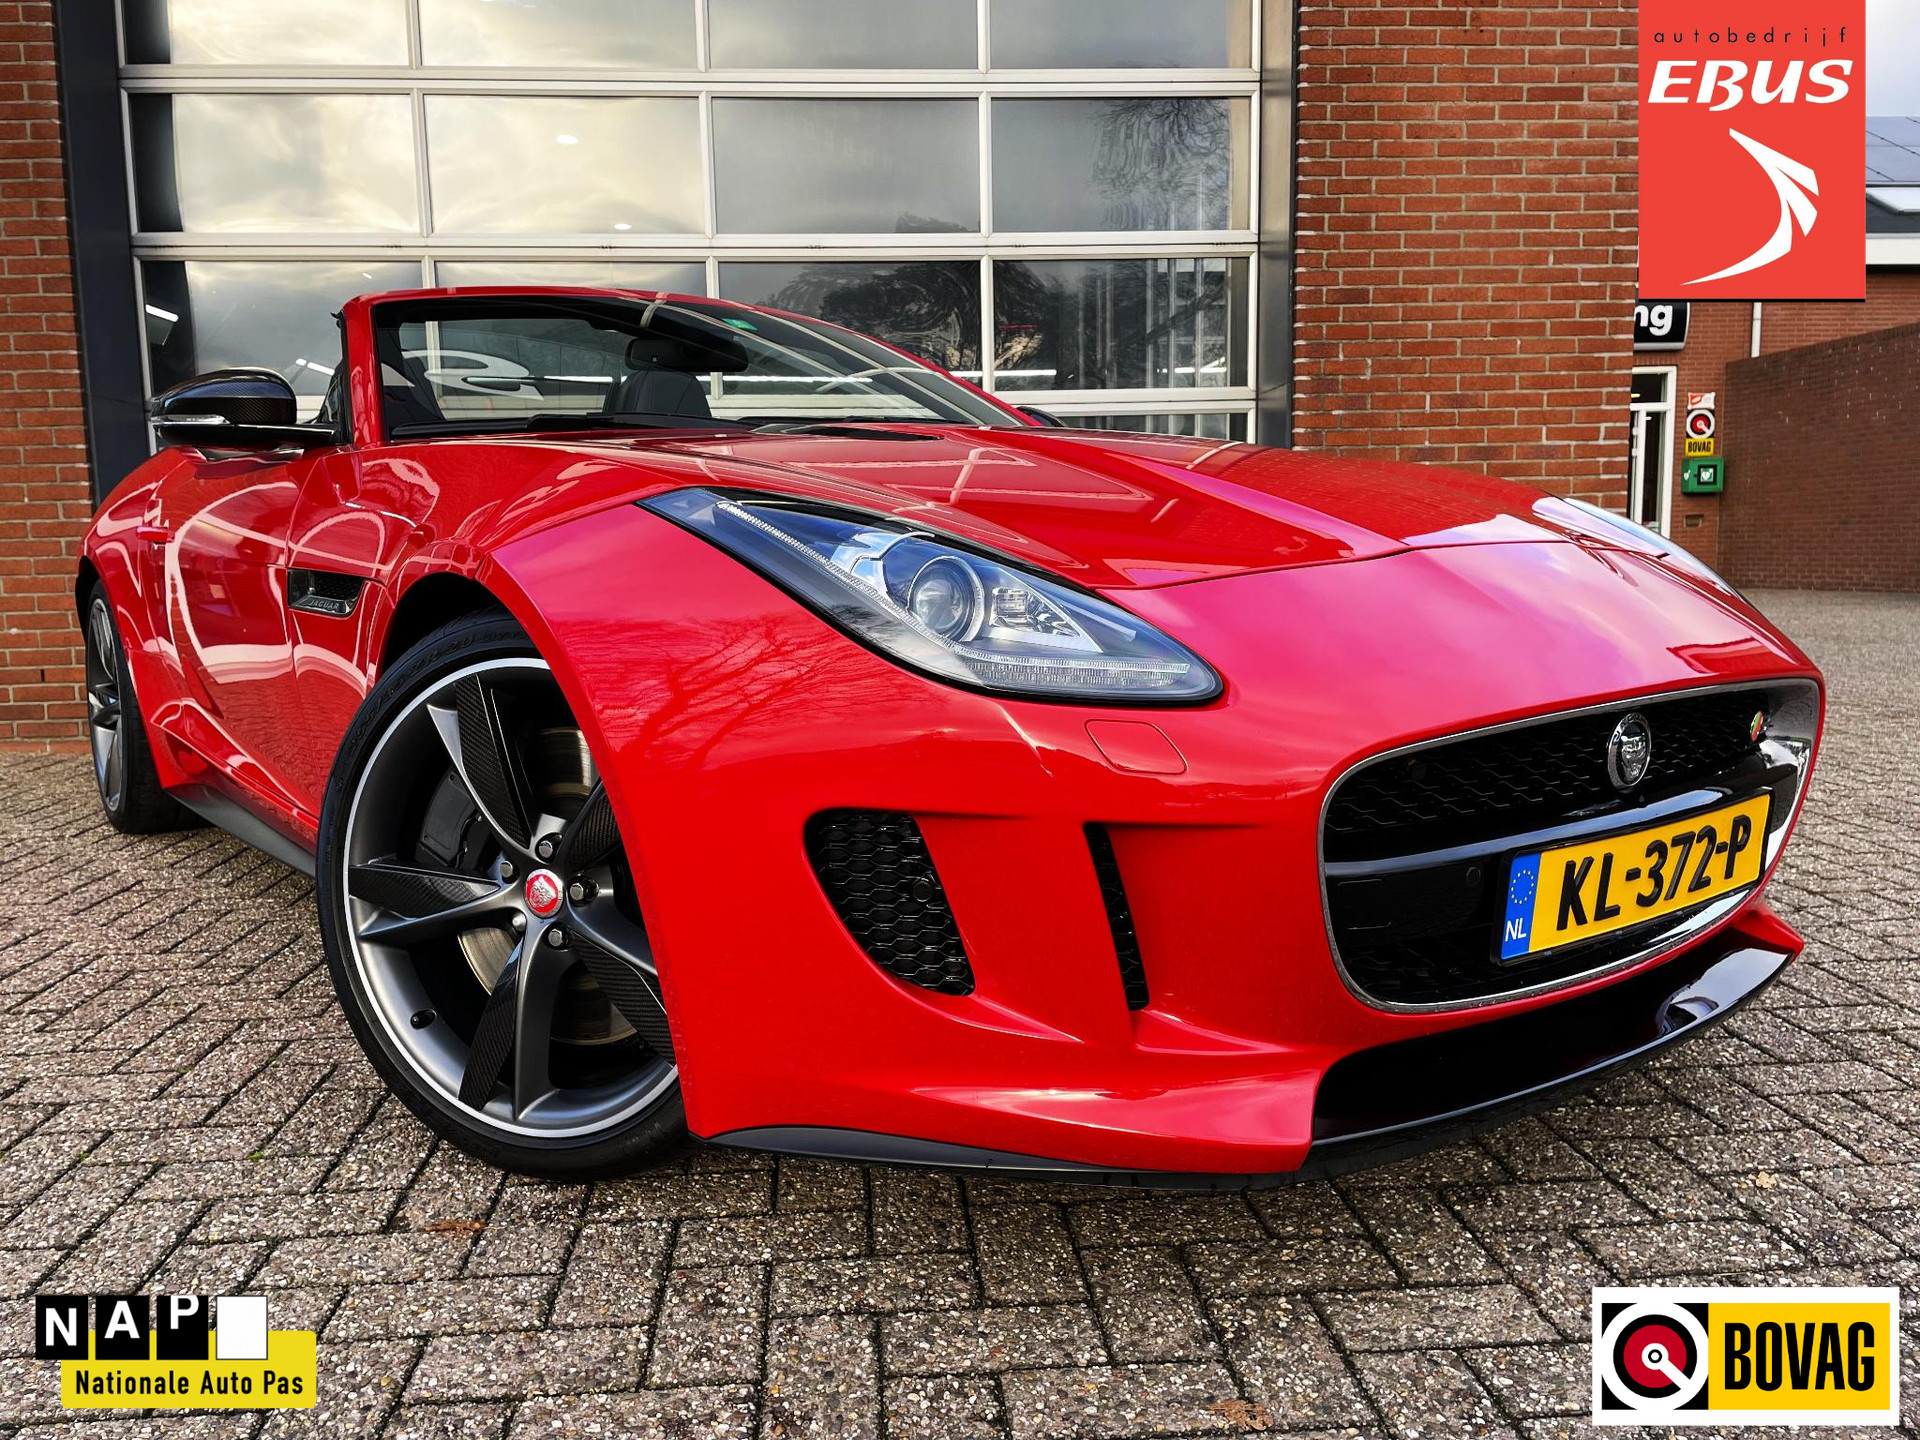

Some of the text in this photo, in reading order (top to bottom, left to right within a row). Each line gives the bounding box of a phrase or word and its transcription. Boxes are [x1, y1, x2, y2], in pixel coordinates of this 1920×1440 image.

[1687, 441, 1711, 452] BOVAG
[309, 599, 340, 610] JAGUAR
[1556, 814, 1751, 931] KL-372-P
[1505, 917, 1527, 942] NL
